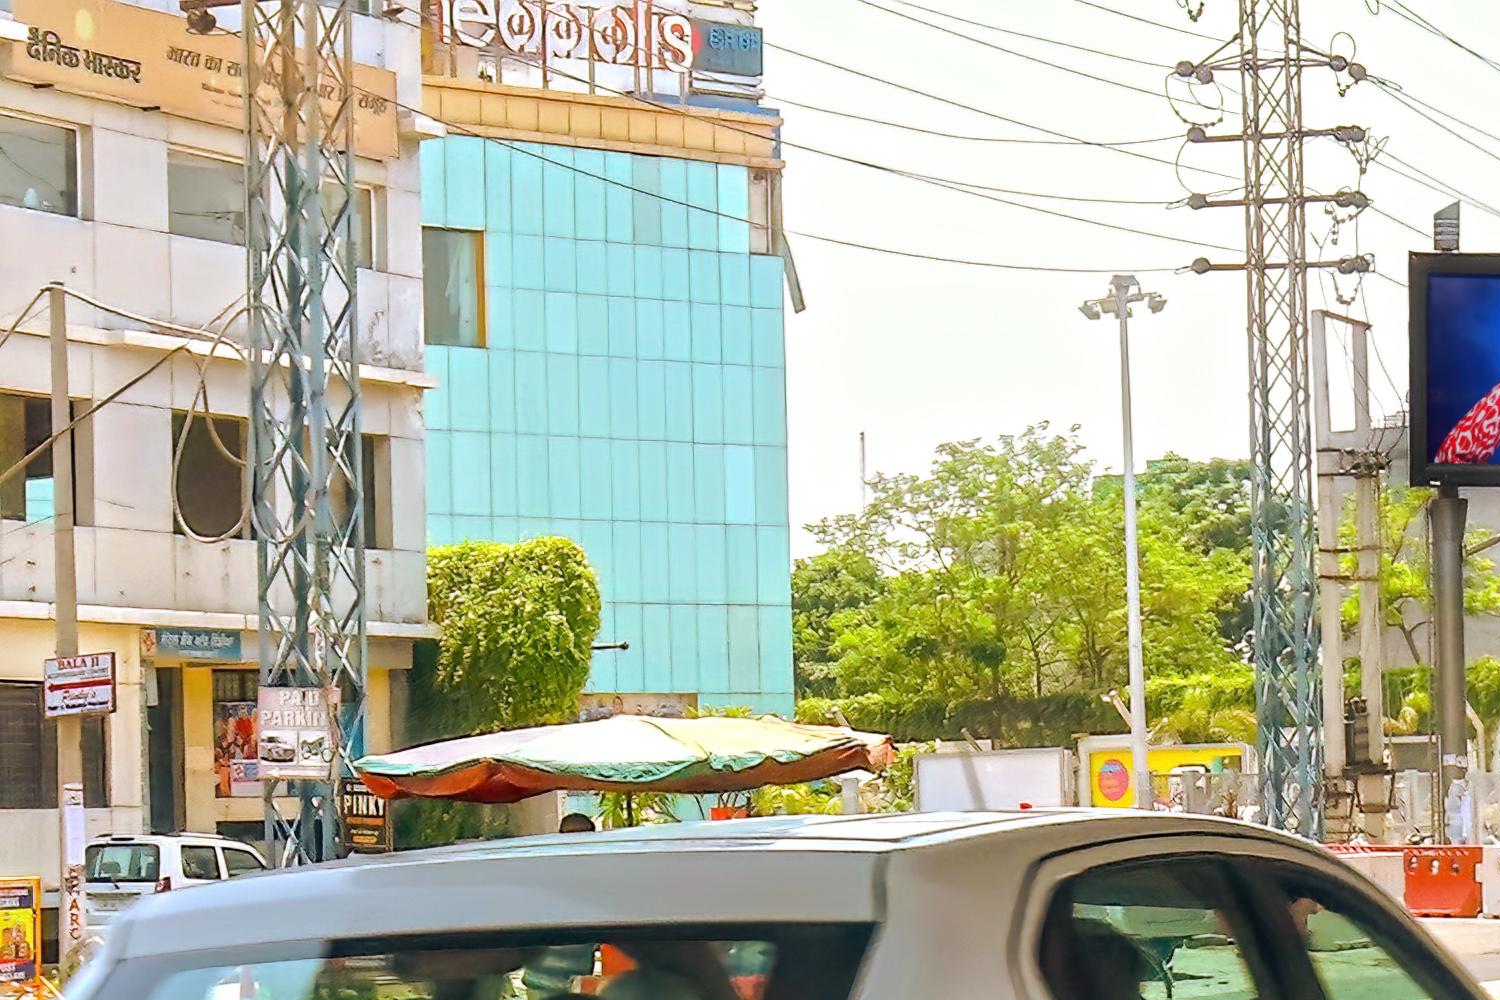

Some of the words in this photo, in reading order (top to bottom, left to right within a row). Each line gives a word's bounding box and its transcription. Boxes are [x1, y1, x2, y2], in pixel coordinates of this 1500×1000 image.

[26, 27, 81, 69] दैनिक
[83, 49, 143, 83] भास्कर
[260, 710, 326, 728] PARKIN
[343, 794, 385, 816] PINKY
